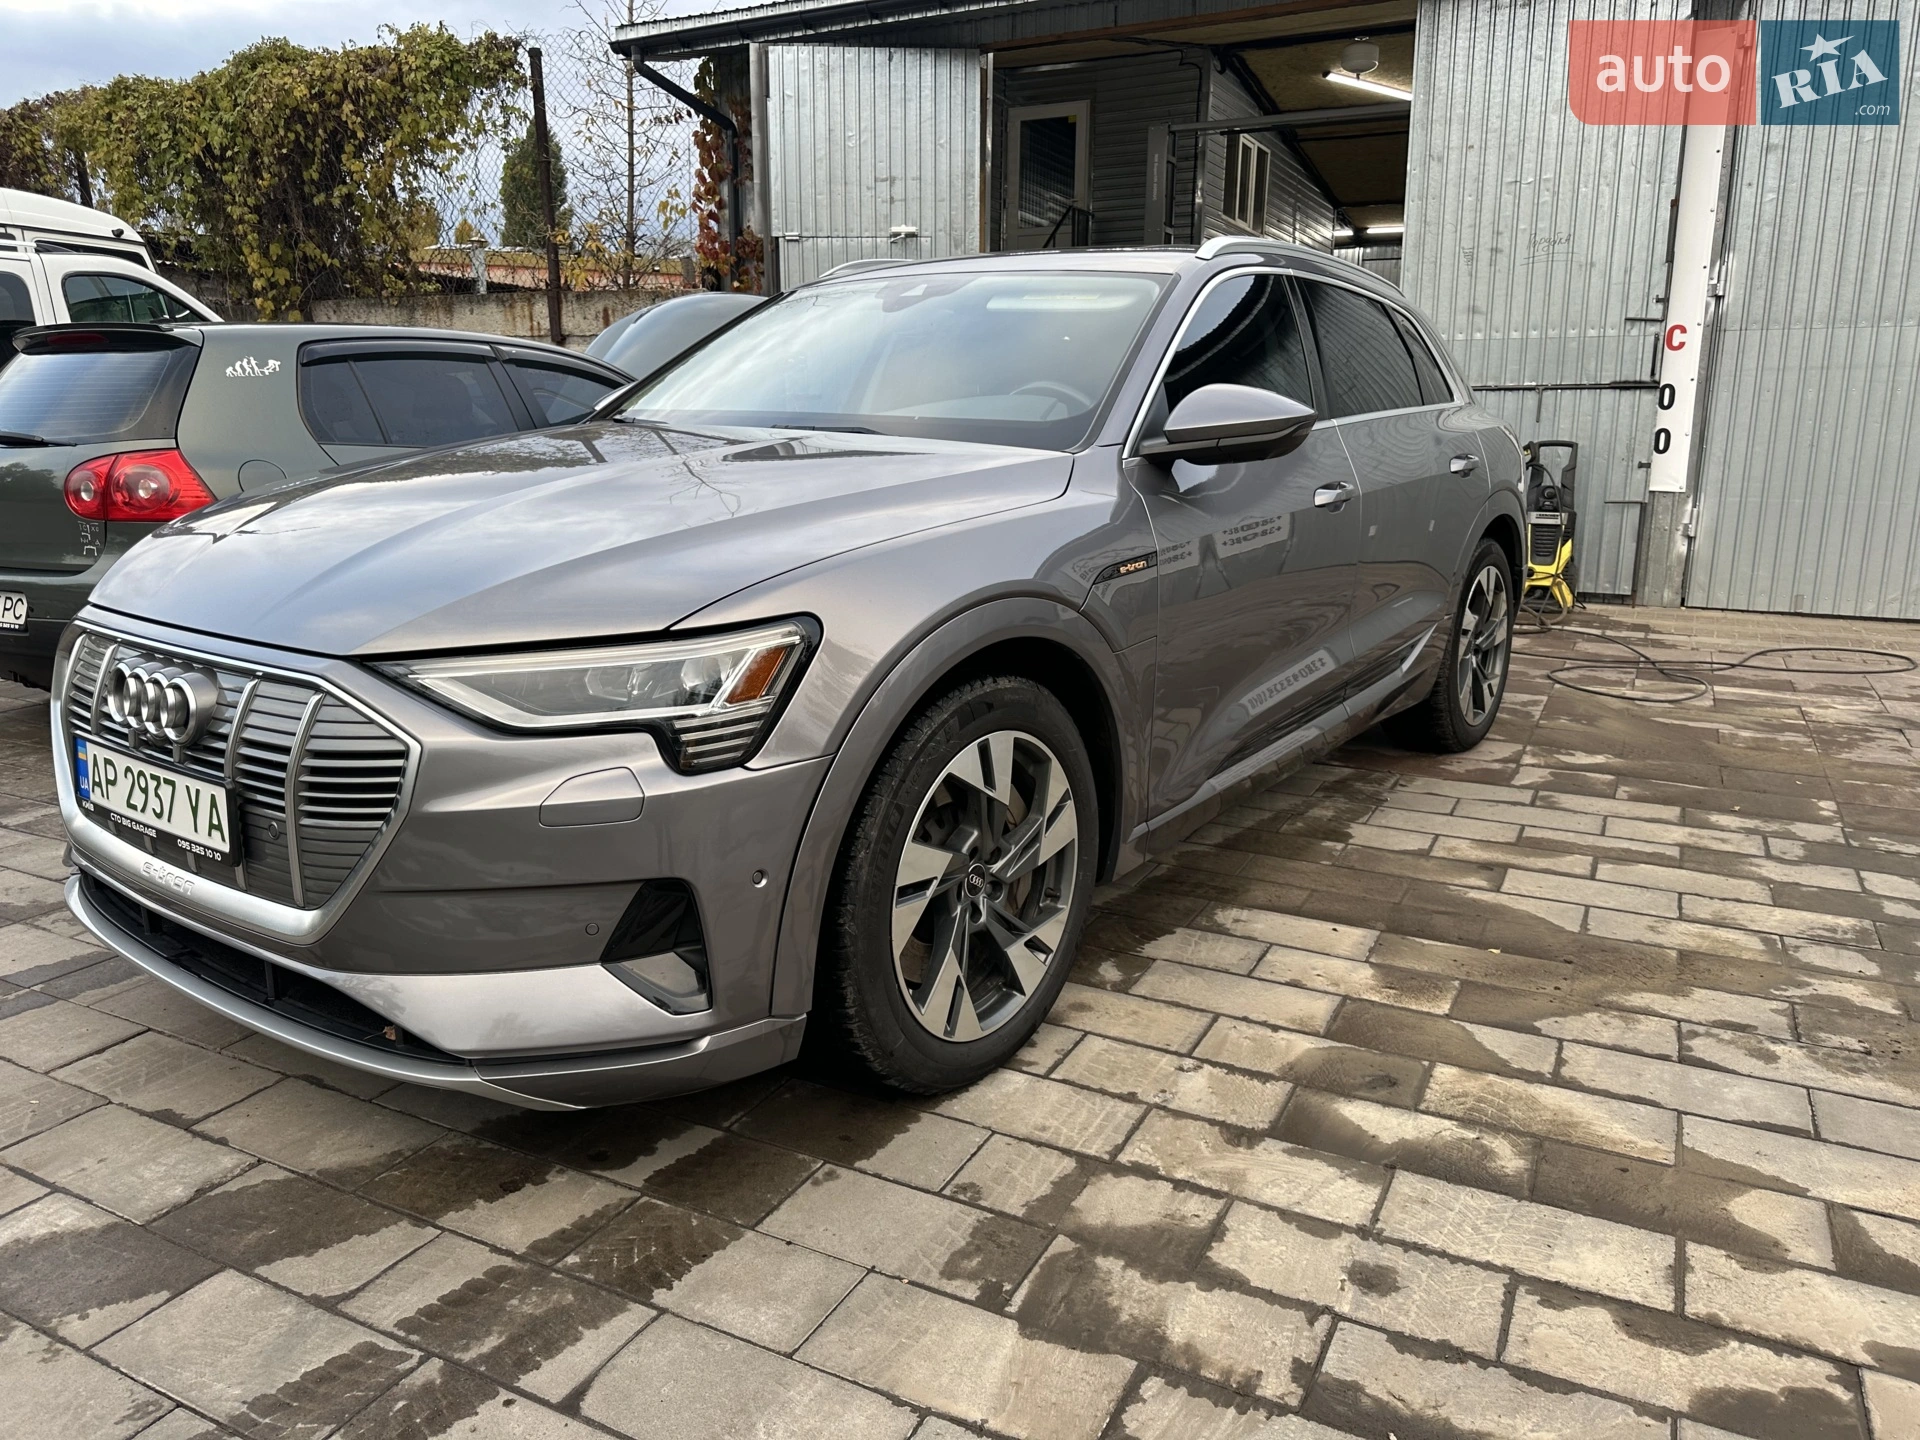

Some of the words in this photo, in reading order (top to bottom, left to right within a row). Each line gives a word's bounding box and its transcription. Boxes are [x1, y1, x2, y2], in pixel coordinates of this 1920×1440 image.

[1119, 560, 1148, 574] e-tron
[2, 596, 25, 620] PC
[80, 776, 90, 790] UA
[92, 753, 118, 801] AP
[124, 765, 177, 823] 2937
[185, 784, 227, 843] YA
[121, 816, 132, 828] BIG
[131, 821, 157, 838] GARAGE
[177, 839, 191, 851] 095
[191, 842, 206, 856] 325
[205, 848, 214, 858] 10
[214, 851, 222, 862] 10
